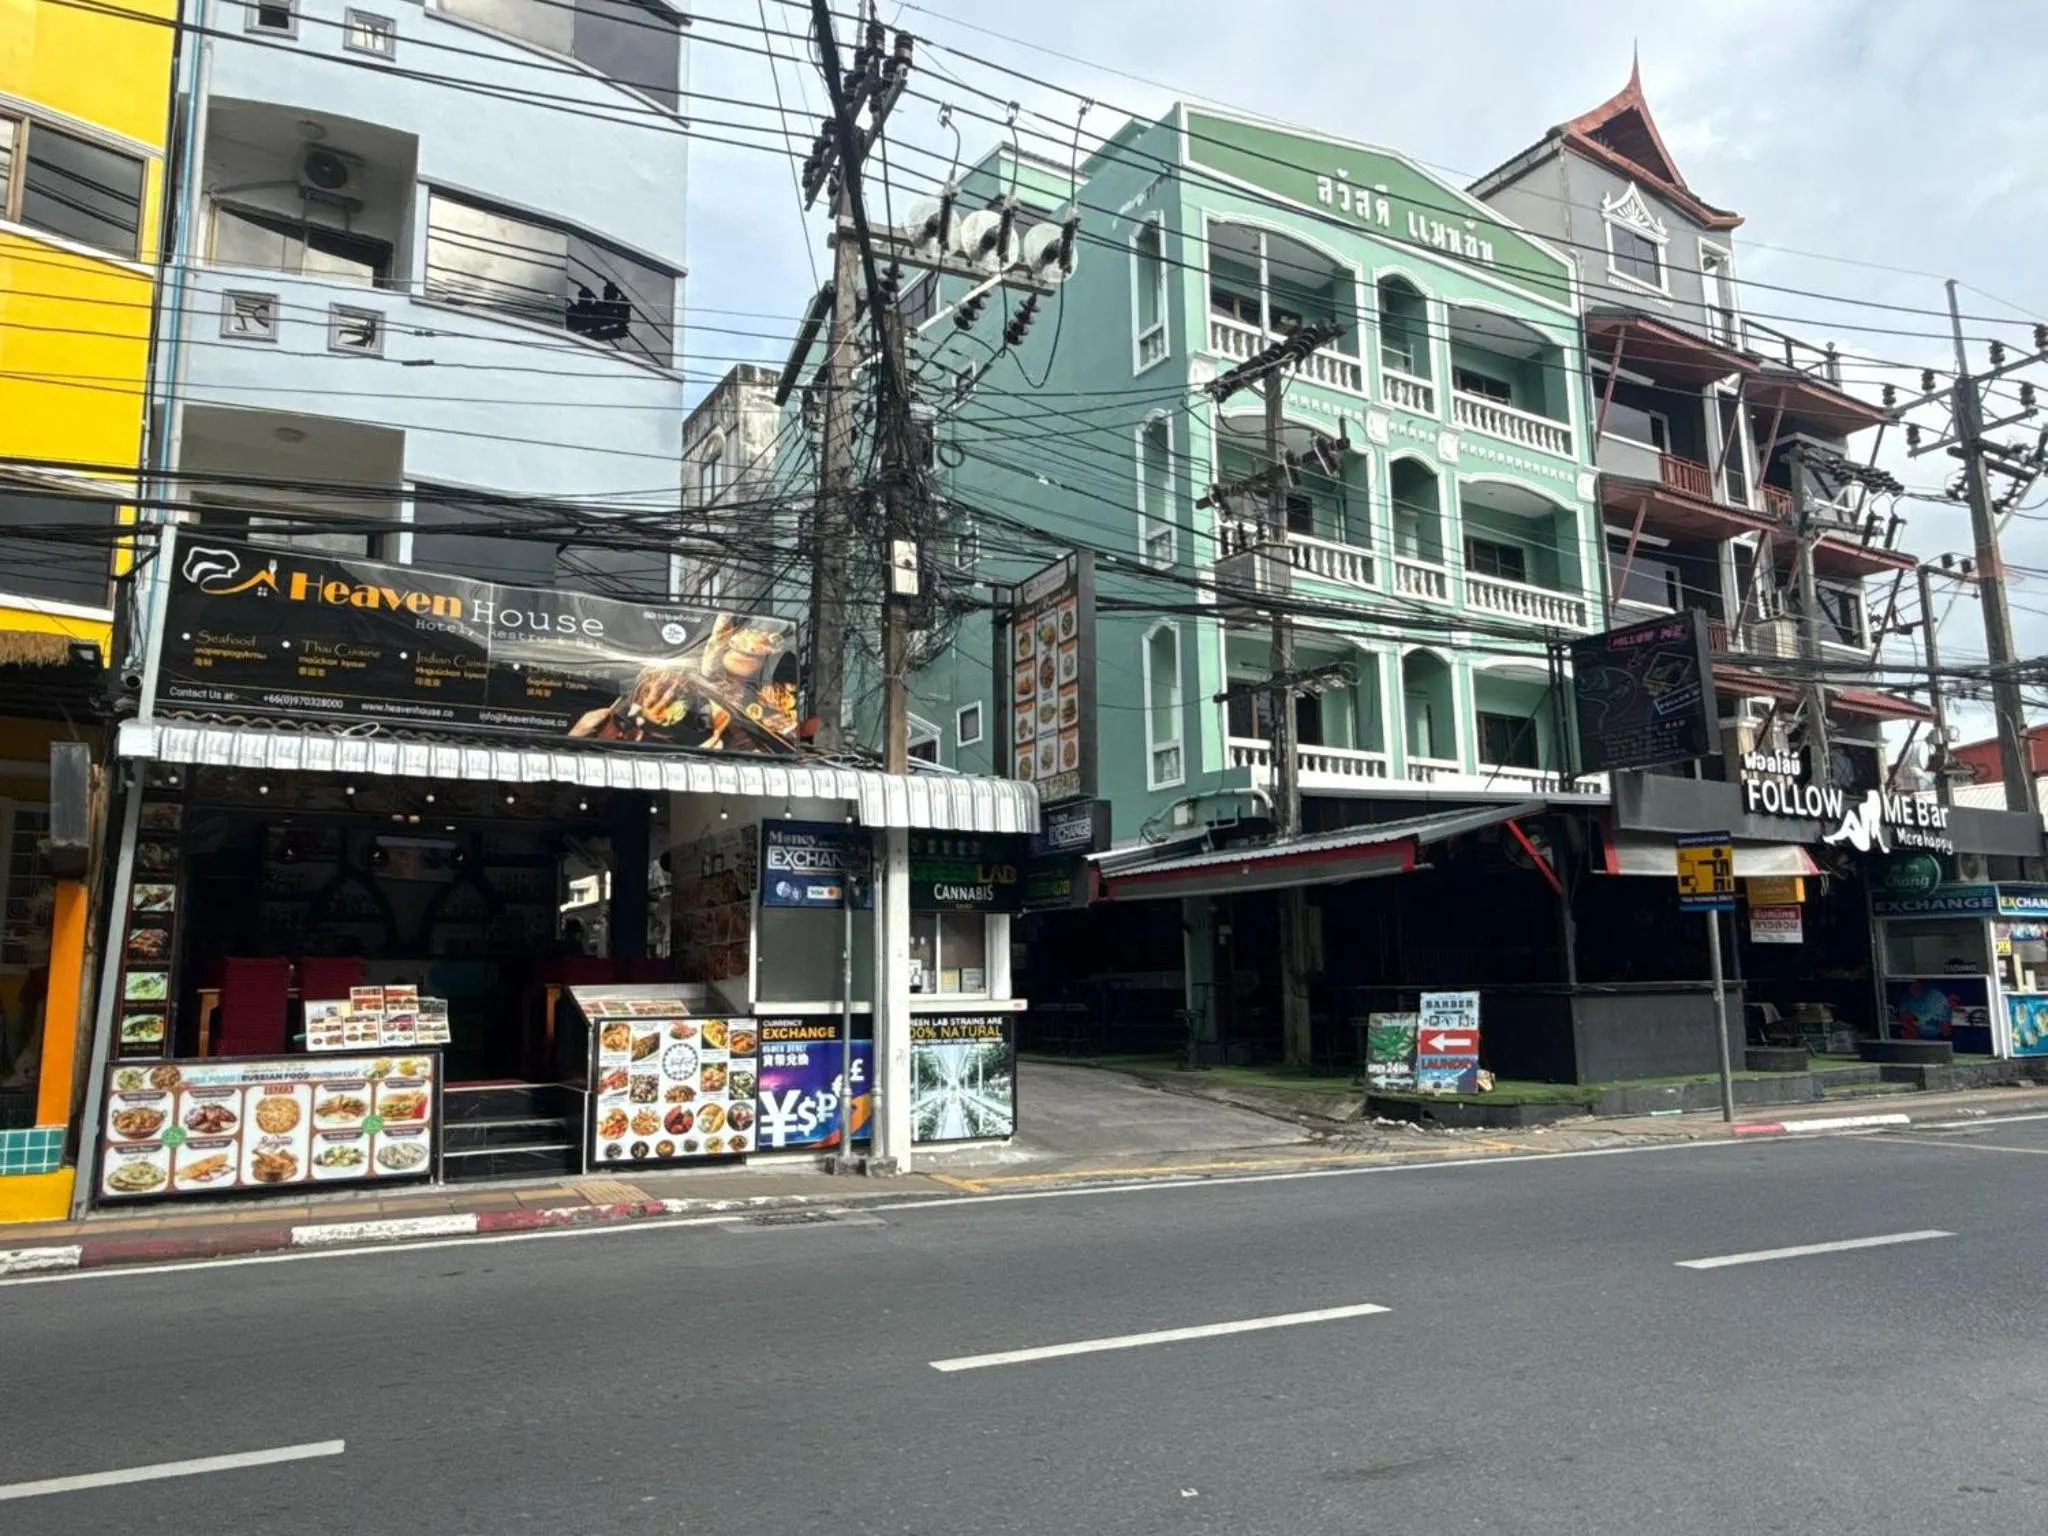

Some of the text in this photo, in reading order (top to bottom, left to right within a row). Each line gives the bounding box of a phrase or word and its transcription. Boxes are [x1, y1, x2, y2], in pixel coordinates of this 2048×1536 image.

[290, 571, 605, 637] Heaven House
[196, 630, 257, 647] Seafood
[302, 639, 382, 659] Thai Cuisine
[416, 650, 452, 667] Indian
[169, 687, 207, 699] Contact
[208, 688, 222, 700] Us
[361, 701, 454, 718] www.heavenhouse.co
[479, 712, 568, 728] info@heavenhouse.co
[1748, 779, 1950, 829] FOLLOW ME Bar
[1885, 874, 1932, 889] Chang
[933, 883, 994, 901] CANNABIS
[1874, 896, 1995, 913] EXCHANGE
[762, 1019, 804, 1028] CURRENCY
[931, 1017, 949, 1026] LAB
[950, 1017, 985, 1026] STRAINS
[986, 1017, 1002, 1025] ARE
[762, 1026, 836, 1040] EXCHANGE
[910, 1024, 1002, 1039] 00% NATURAL
[241, 1072, 282, 1081] RUSSIAN
[284, 1071, 311, 1080] FOOD
